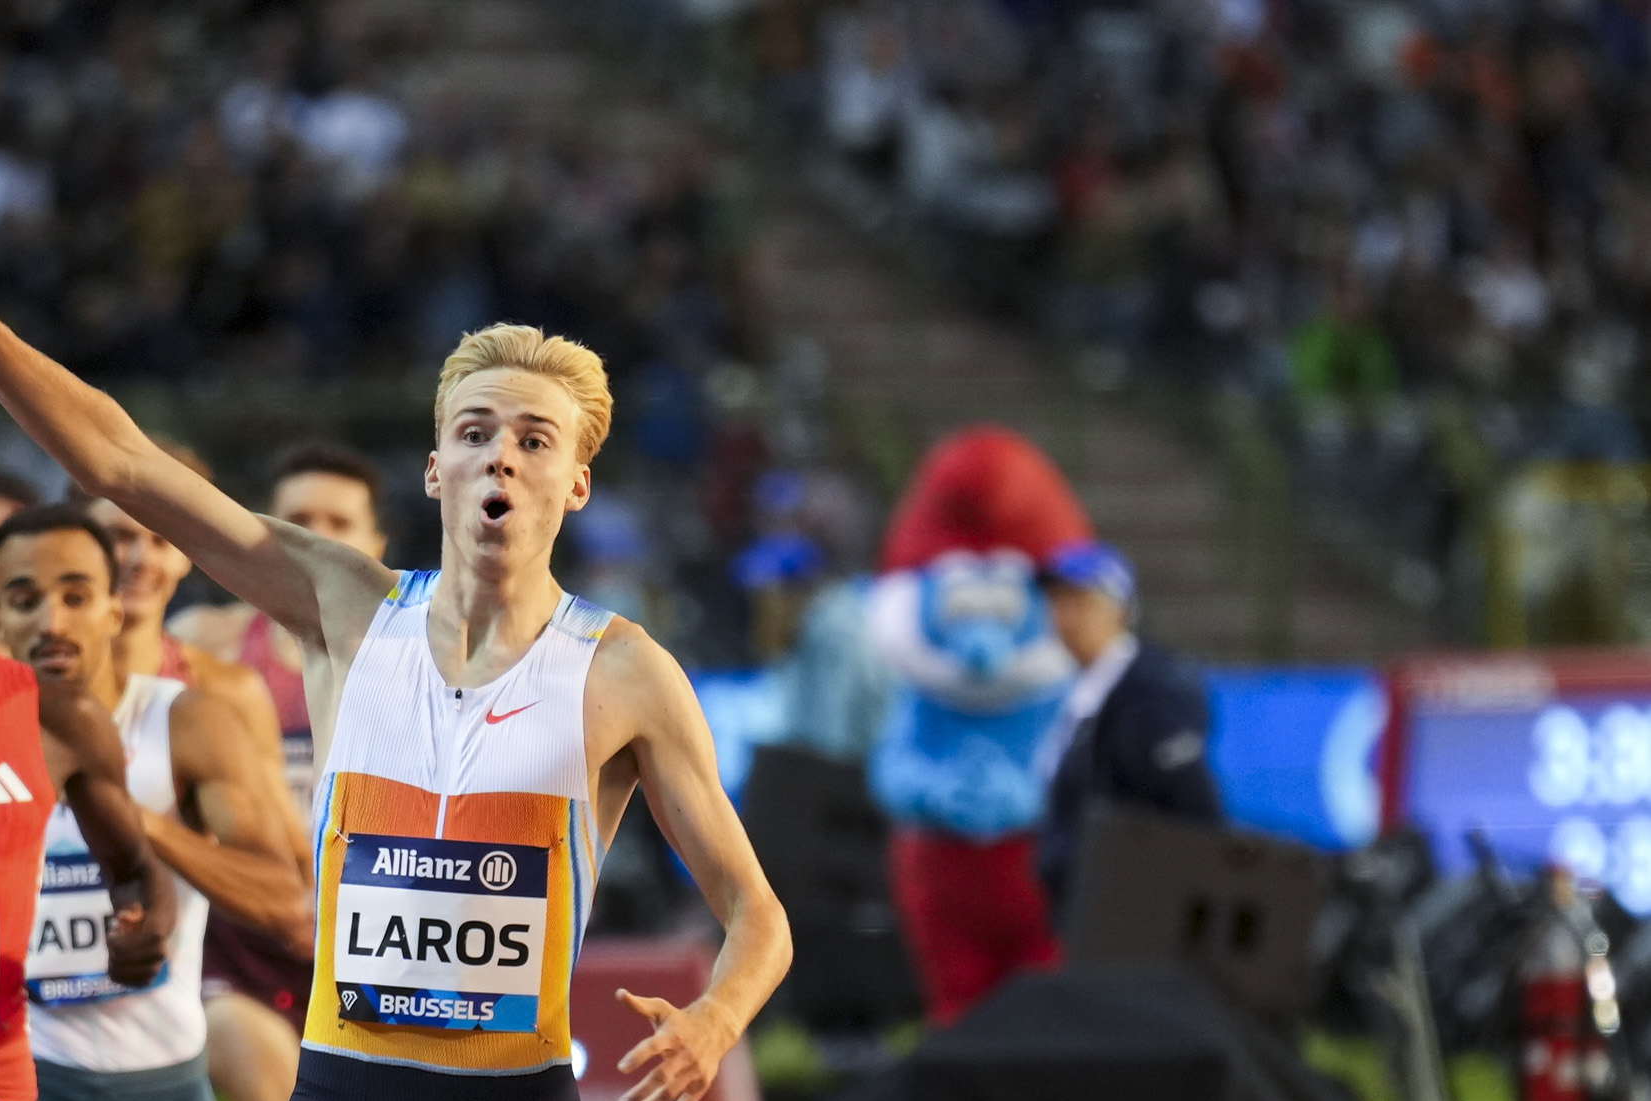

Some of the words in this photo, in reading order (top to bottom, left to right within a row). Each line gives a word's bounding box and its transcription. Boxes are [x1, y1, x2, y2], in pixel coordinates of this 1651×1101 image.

[371, 847, 471, 881] Allianz
[347, 911, 530, 967] LAROS
[379, 994, 494, 1021] BRUSSELS
